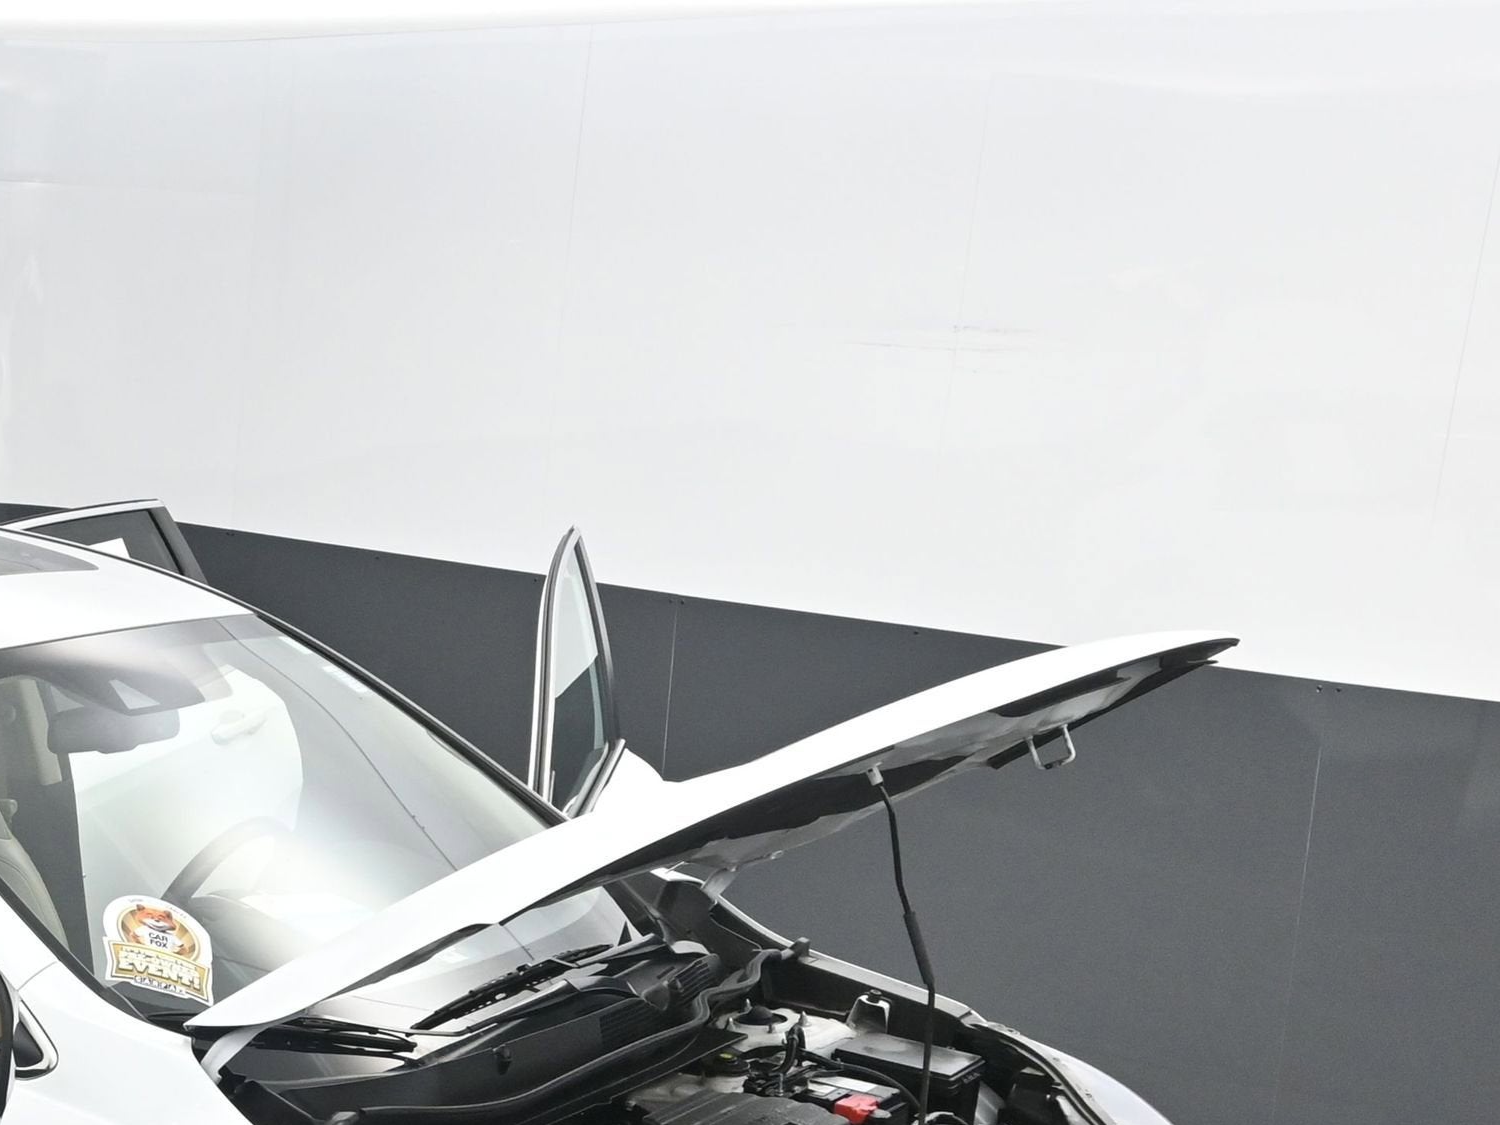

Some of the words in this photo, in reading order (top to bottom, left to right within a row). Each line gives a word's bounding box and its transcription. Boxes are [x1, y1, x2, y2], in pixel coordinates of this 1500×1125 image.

[148, 931, 169, 943] CAR
[149, 939, 169, 950] FOX
[117, 957, 201, 991] EVENT!
